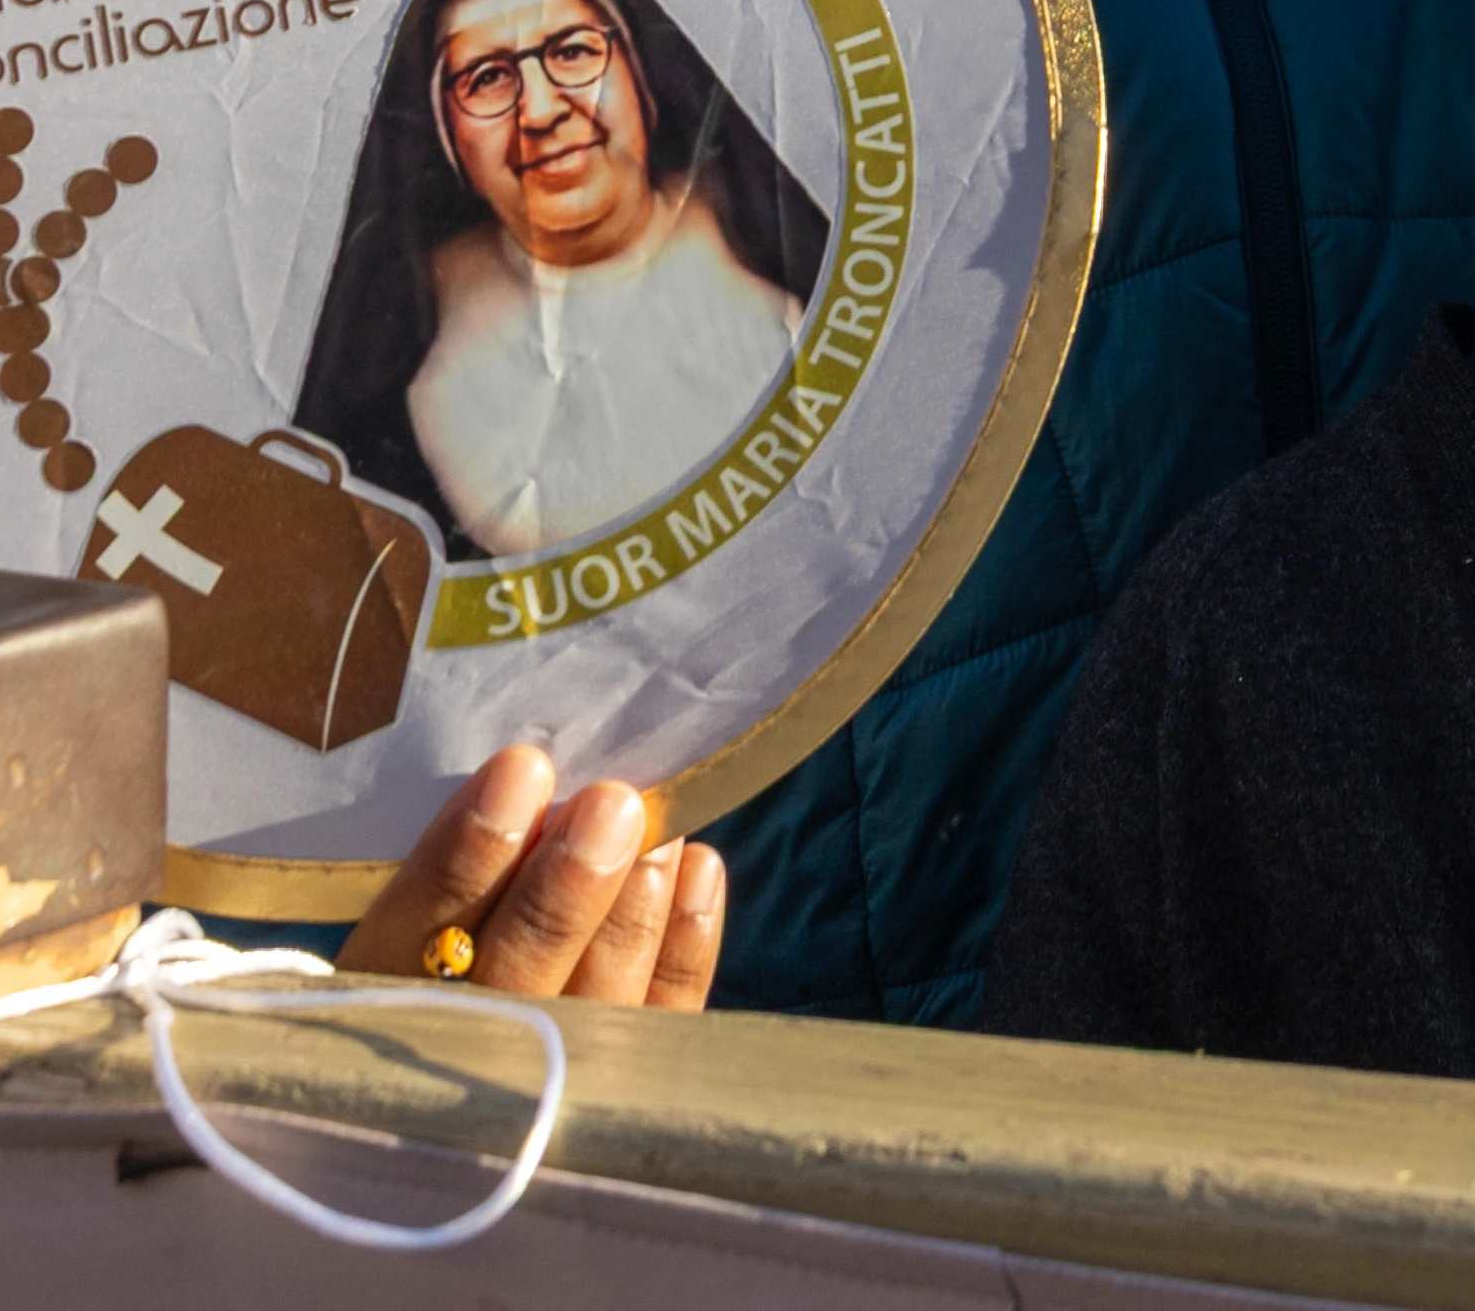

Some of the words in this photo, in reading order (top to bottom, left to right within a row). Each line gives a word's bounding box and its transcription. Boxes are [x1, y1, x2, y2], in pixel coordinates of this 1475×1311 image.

[485, 534, 666, 636] SUOR
[666, 383, 842, 558] MARIA
[810, 27, 906, 370] TRONCATTI
